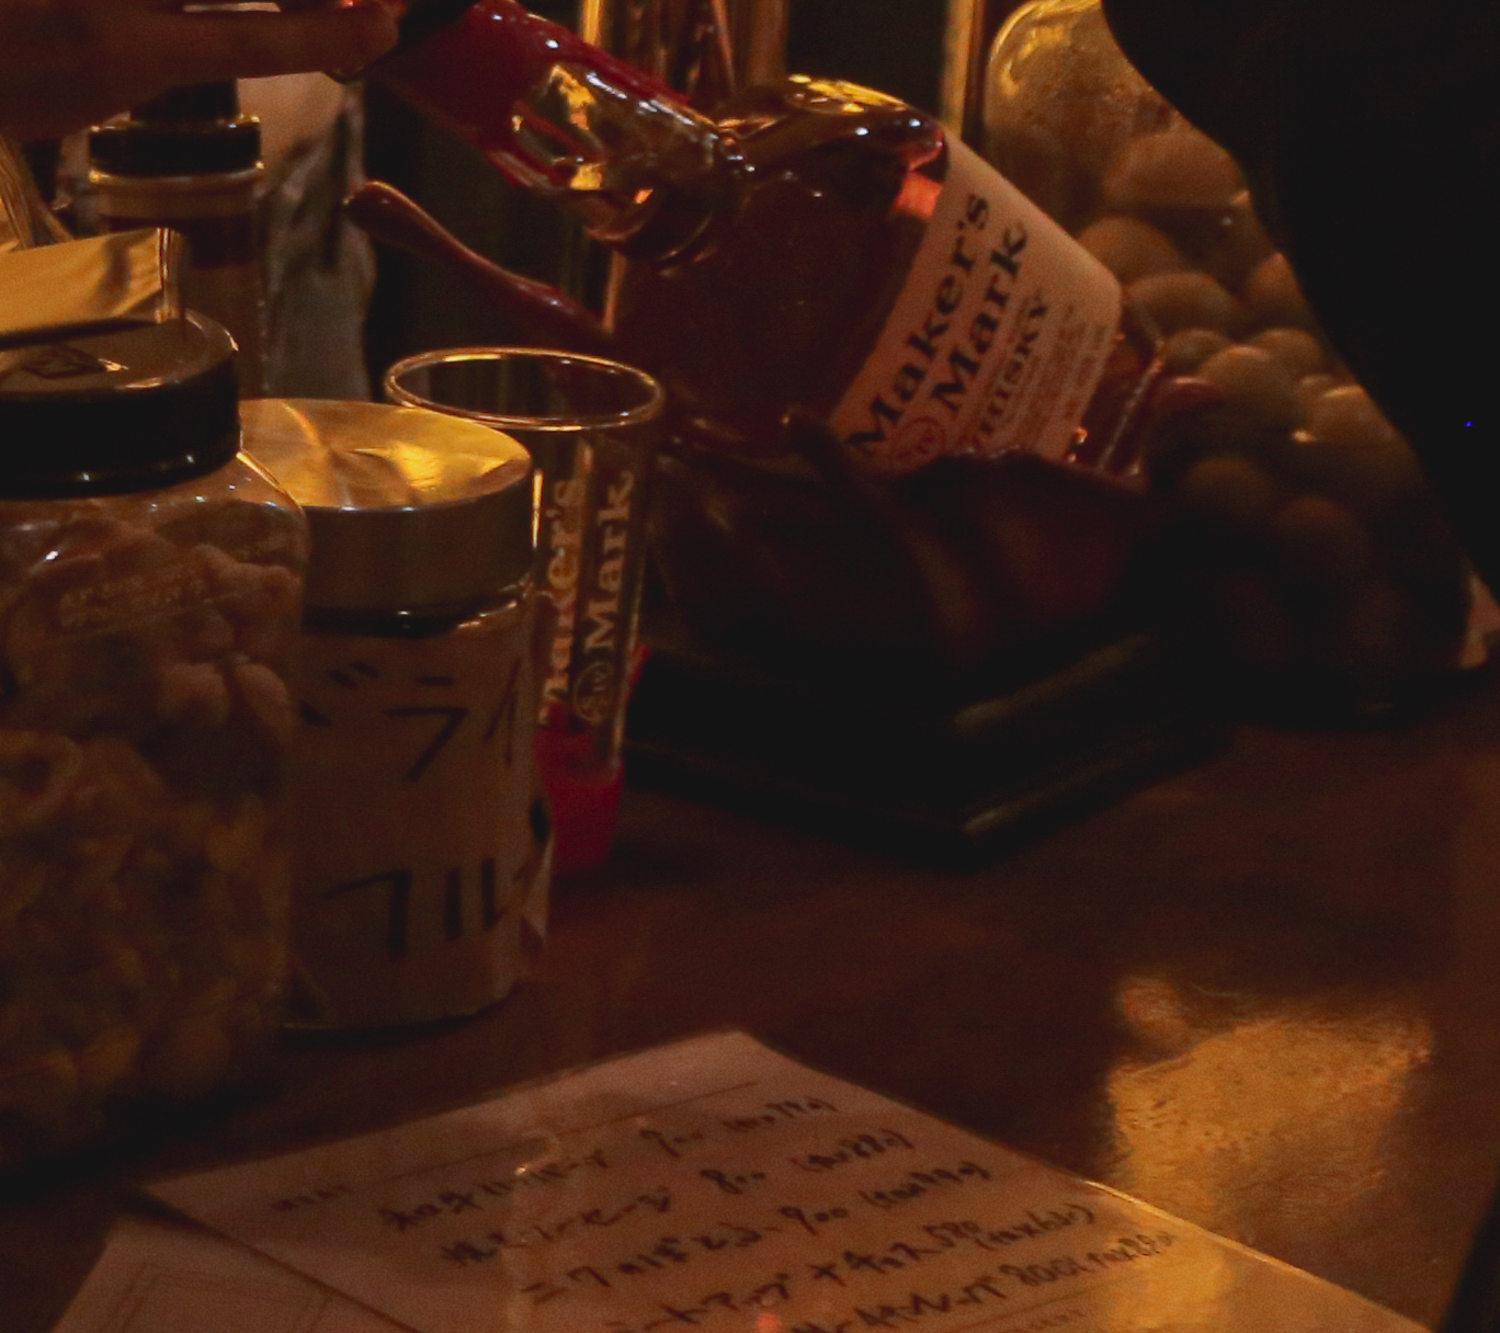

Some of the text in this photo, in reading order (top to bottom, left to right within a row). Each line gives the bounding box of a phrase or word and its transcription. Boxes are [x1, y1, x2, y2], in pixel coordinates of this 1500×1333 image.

[846, 193, 991, 454] Maker's
[930, 220, 1029, 416] Mark
[583, 470, 635, 654] Mark
[776, 1204, 850, 1237] 900
